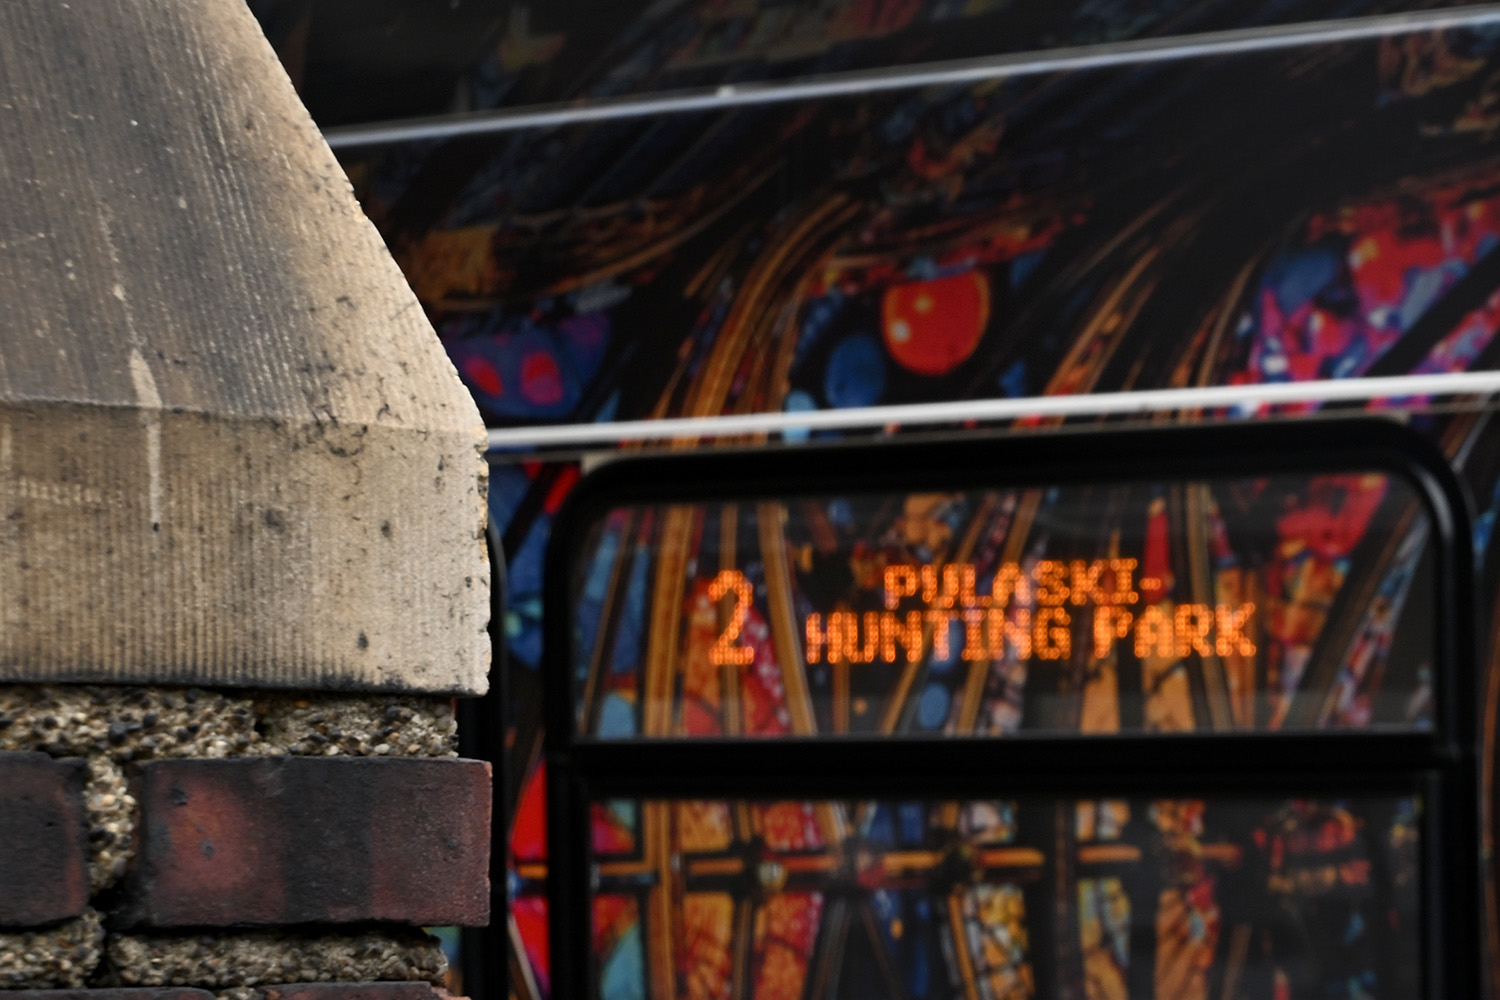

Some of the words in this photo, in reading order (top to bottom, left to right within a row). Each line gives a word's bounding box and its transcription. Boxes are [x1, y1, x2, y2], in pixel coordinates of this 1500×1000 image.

[884, 557, 1162, 611] PULASKI-
[707, 569, 755, 666] 2
[805, 604, 1072, 665] HUNTING
[1094, 601, 1256, 659] PARK
